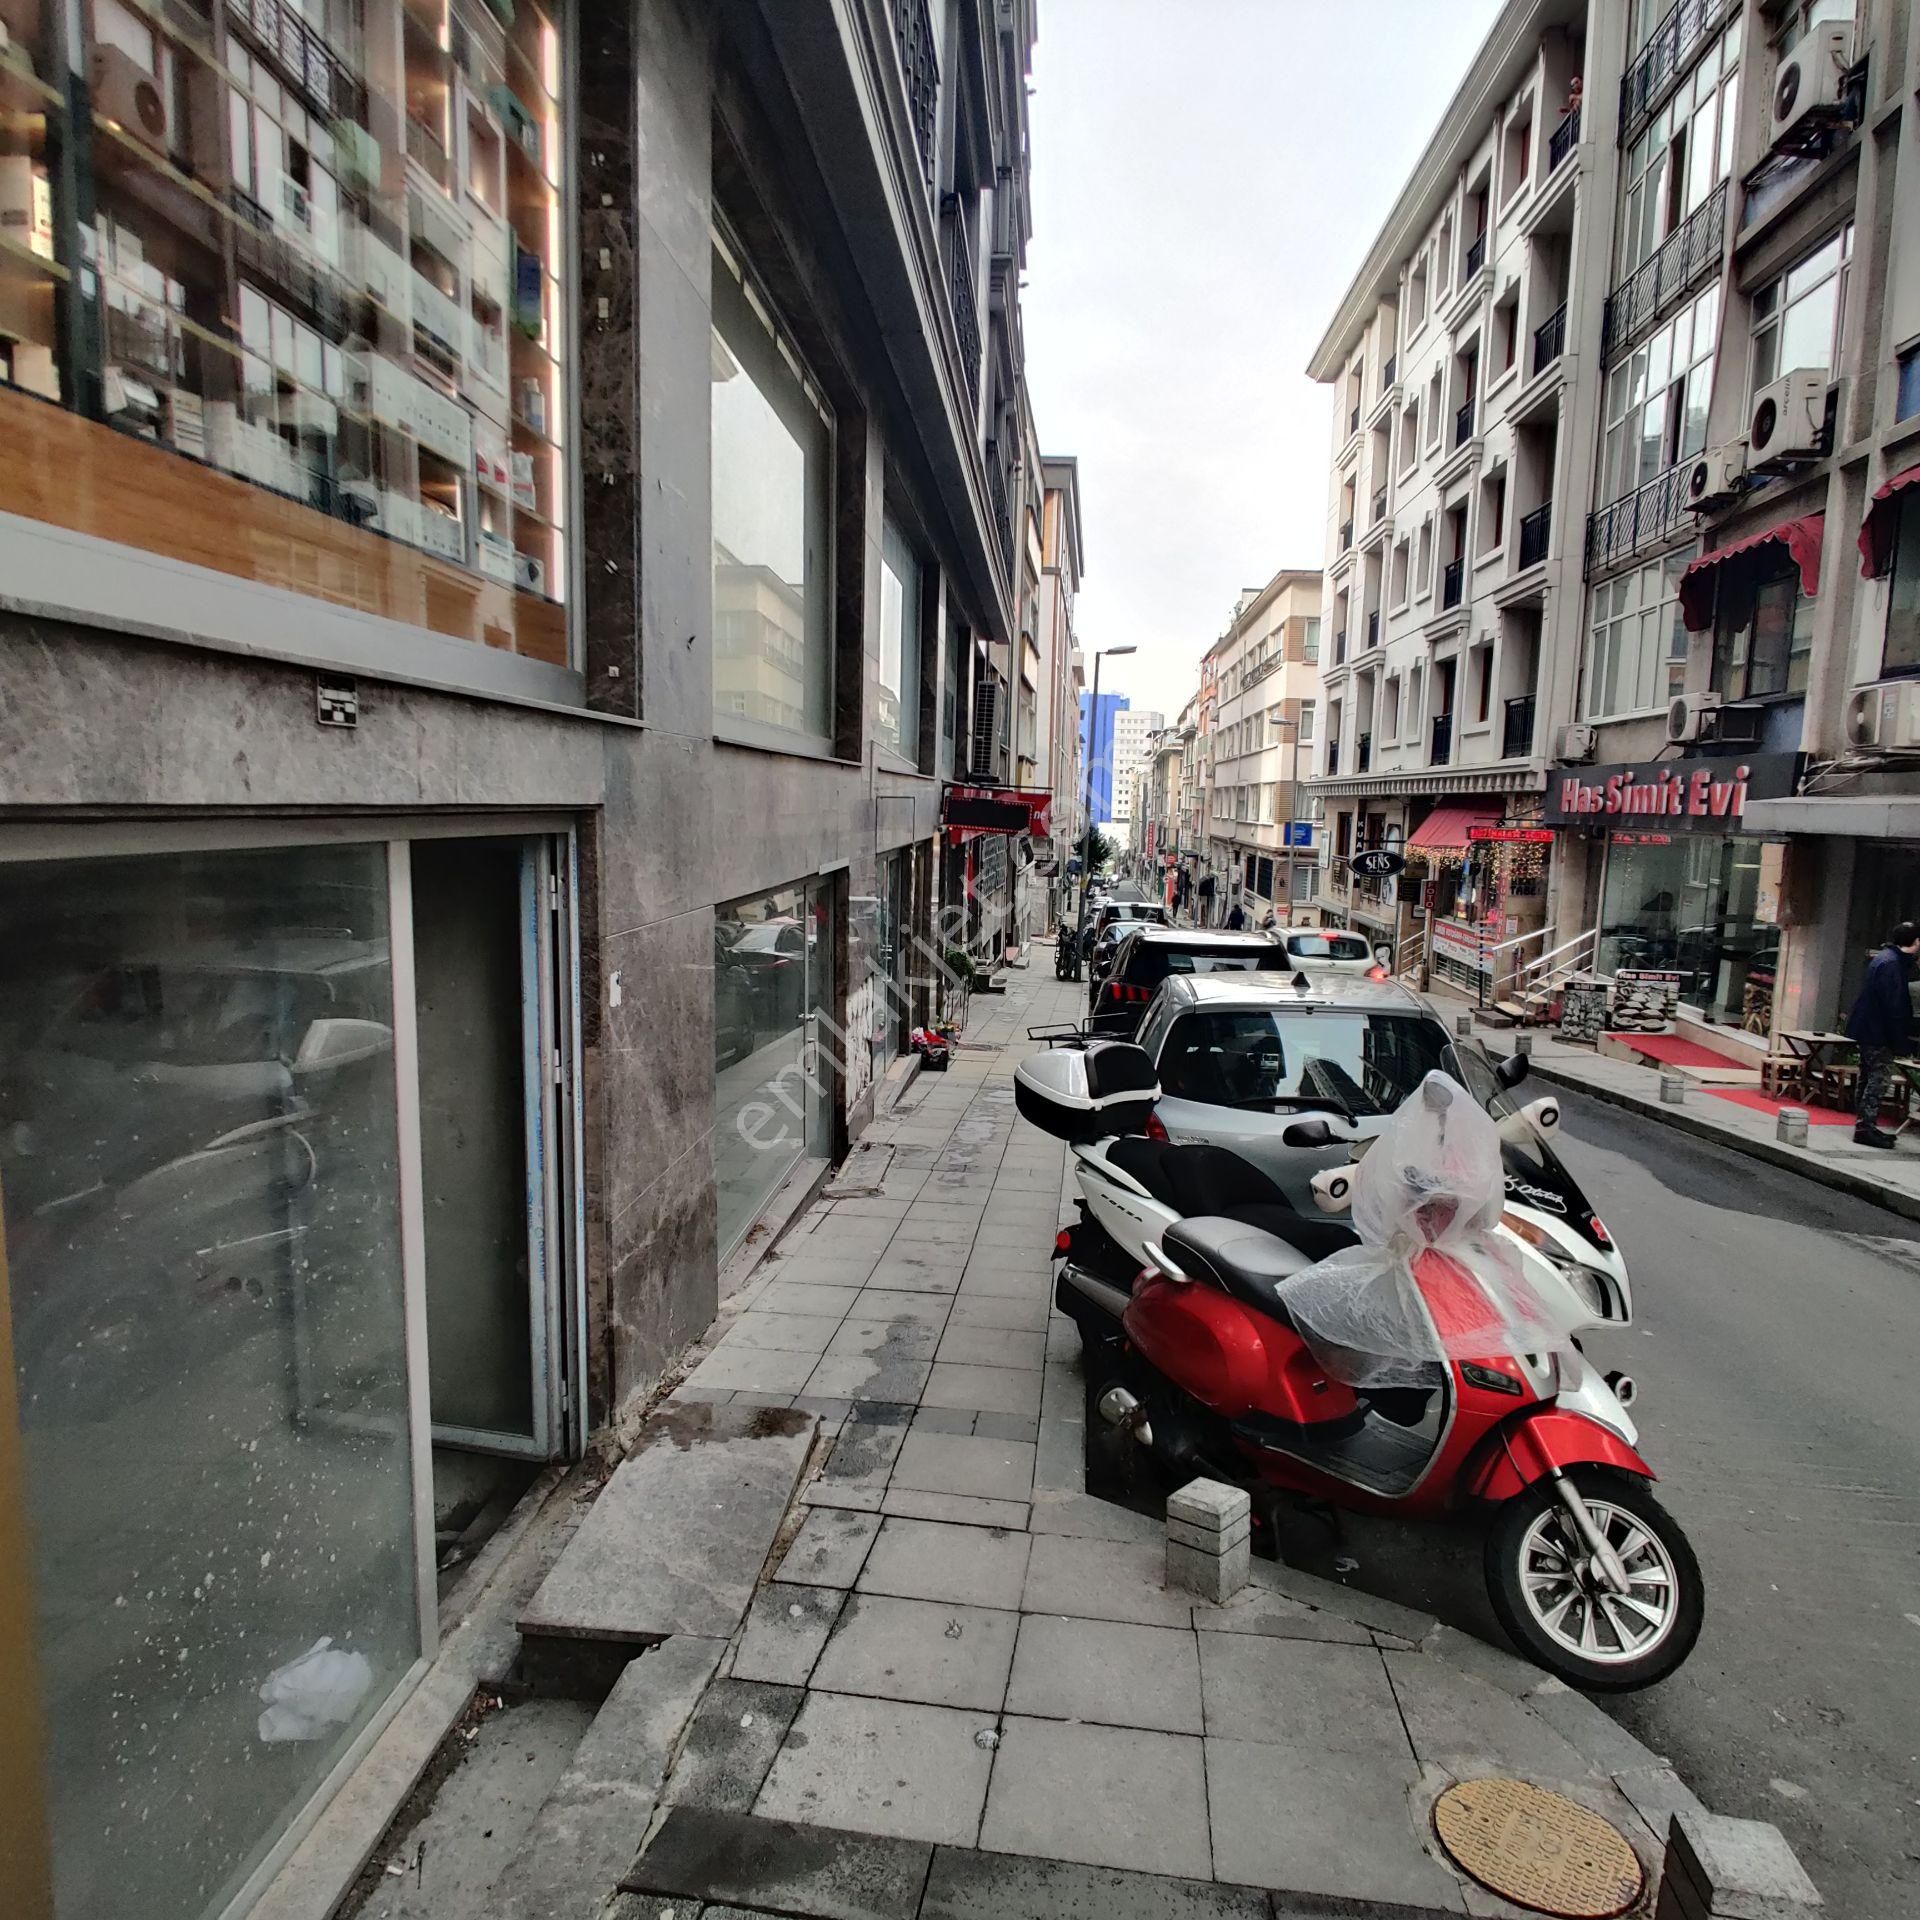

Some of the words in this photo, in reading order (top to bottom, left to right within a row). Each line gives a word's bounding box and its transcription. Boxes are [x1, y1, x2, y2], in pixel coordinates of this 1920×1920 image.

[1560, 777, 1604, 813] Has
[1605, 769, 1684, 815] Simit
[1688, 765, 1750, 816] Evi
[1100, 1193, 1143, 1223] FORZA
